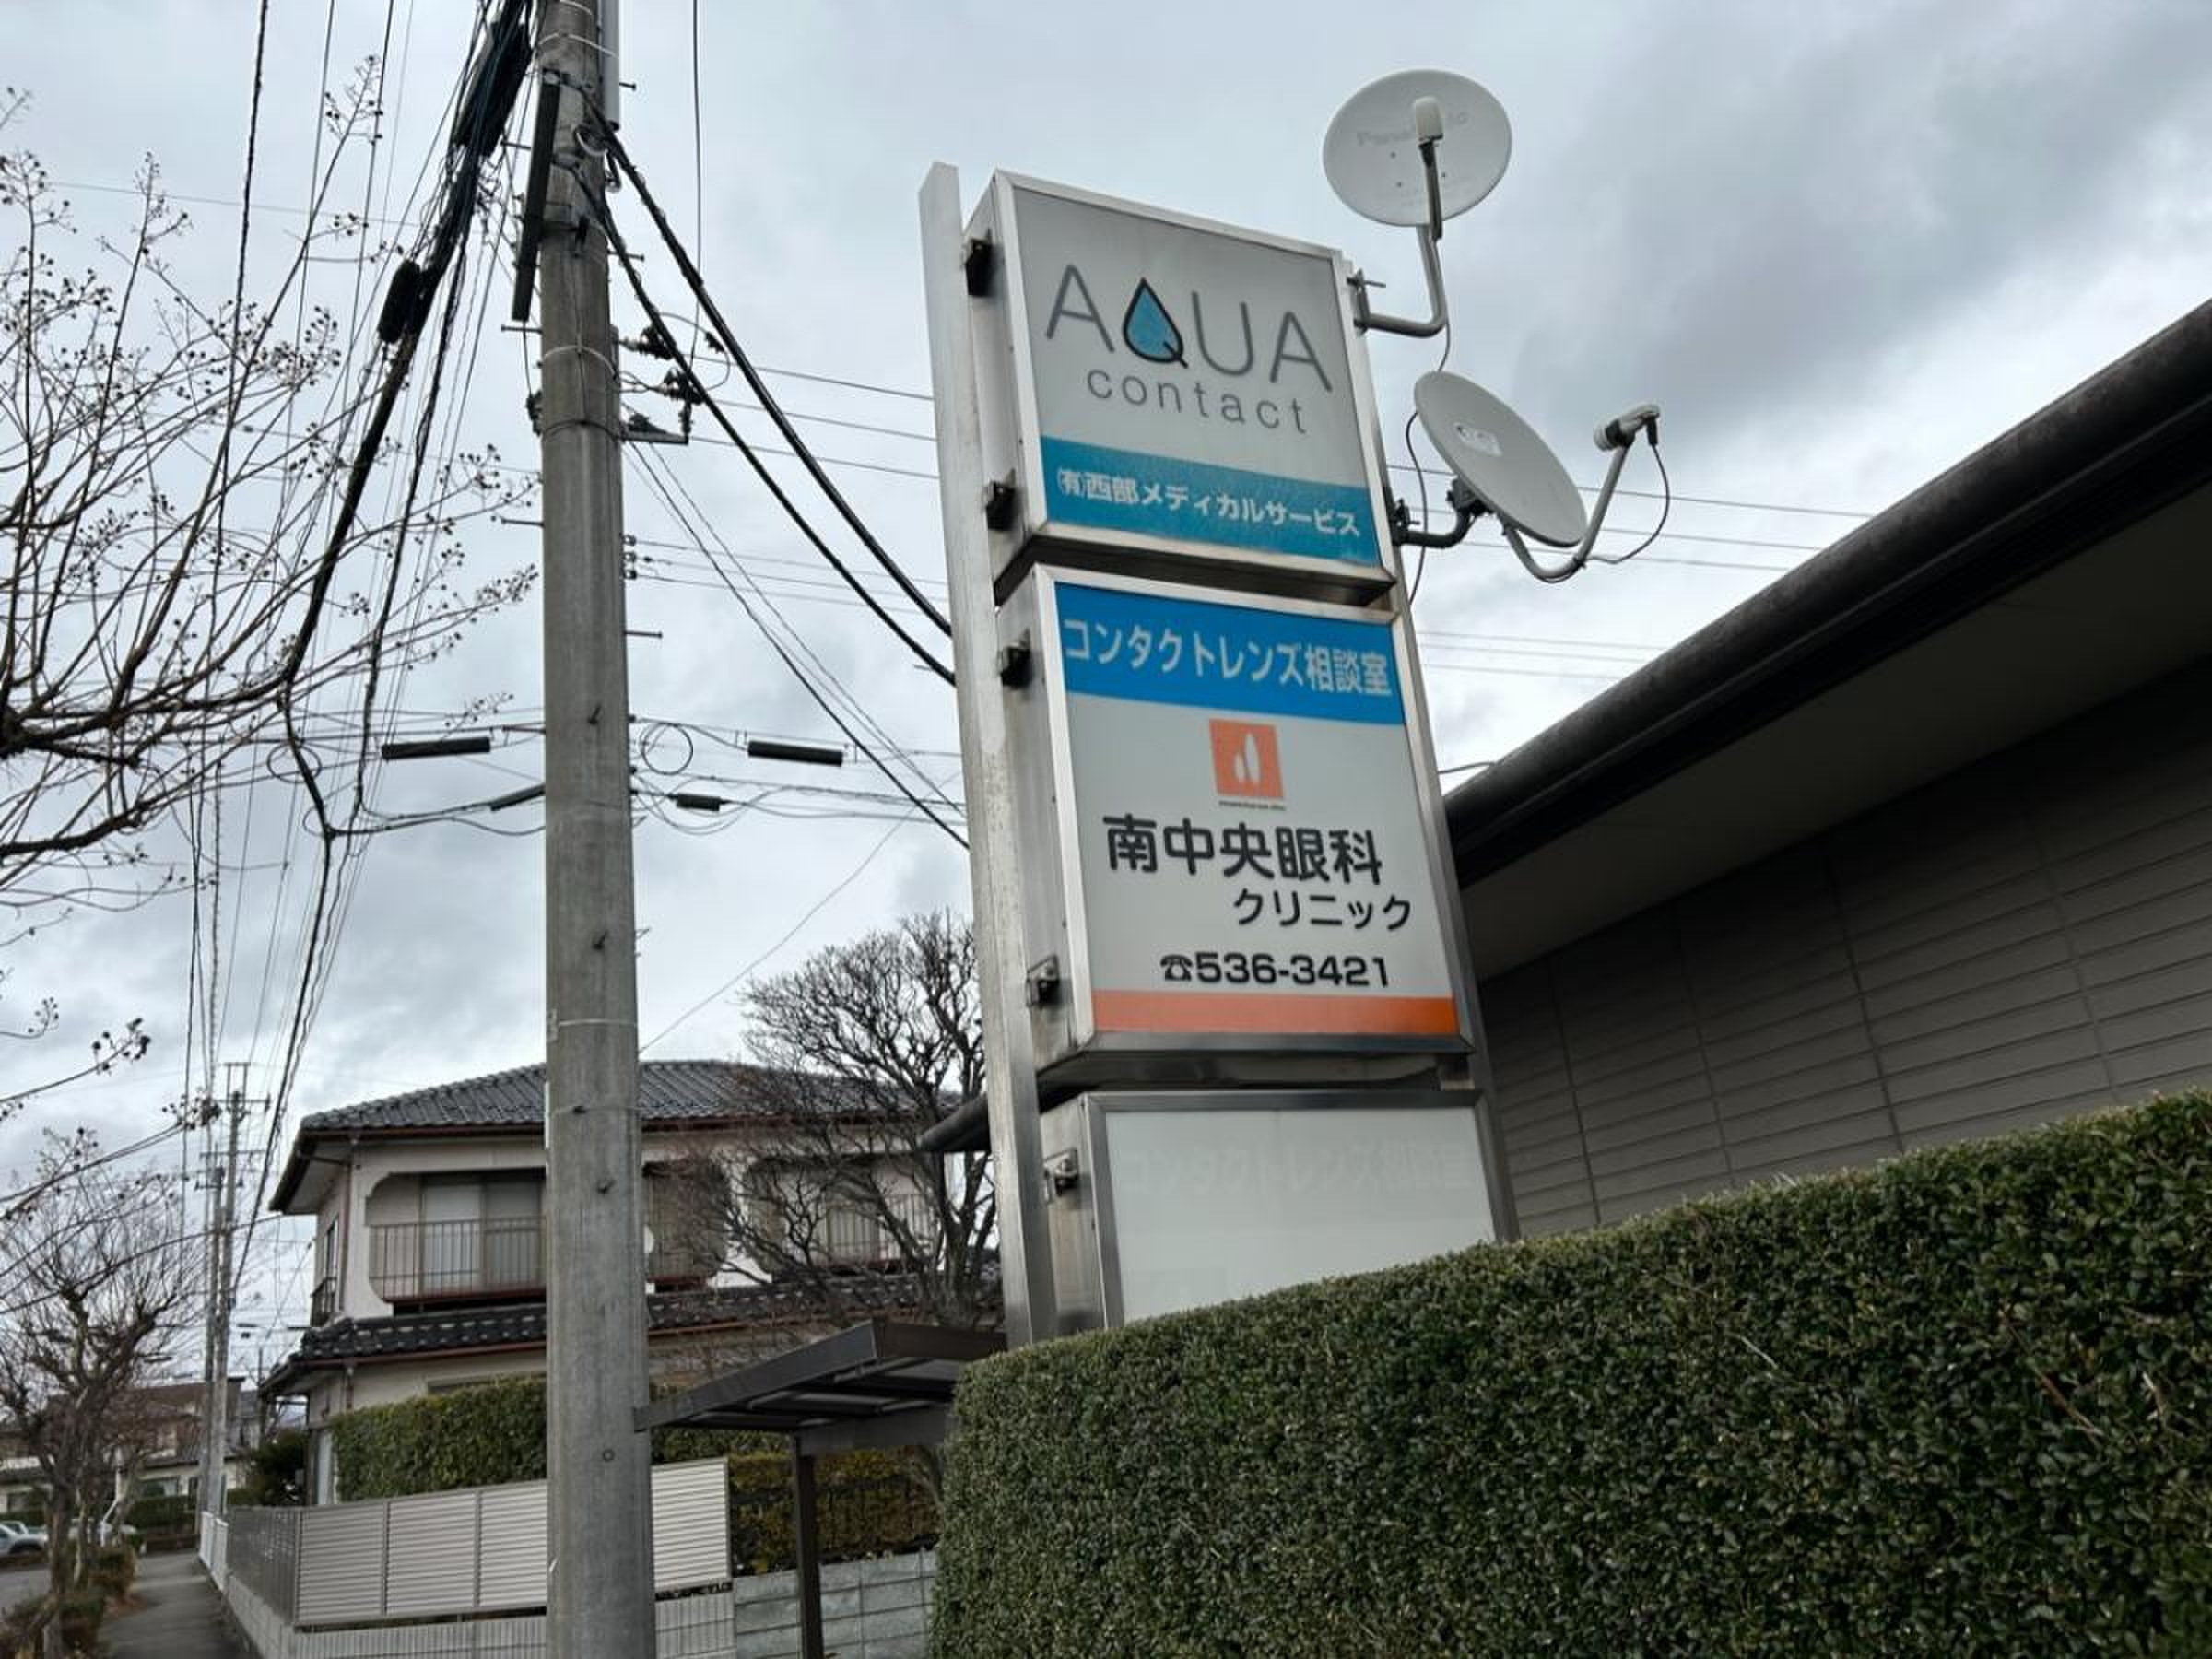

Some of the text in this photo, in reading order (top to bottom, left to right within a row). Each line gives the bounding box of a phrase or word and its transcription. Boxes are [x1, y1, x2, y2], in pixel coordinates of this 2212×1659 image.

[1045, 265, 1333, 393] AQUA
[1086, 369, 1307, 434] contact
[1063, 618, 1393, 696] コンタクトレンズ相談室
[1102, 813, 1382, 885] 南中央眼科
[1233, 888, 1411, 932] クリニック
